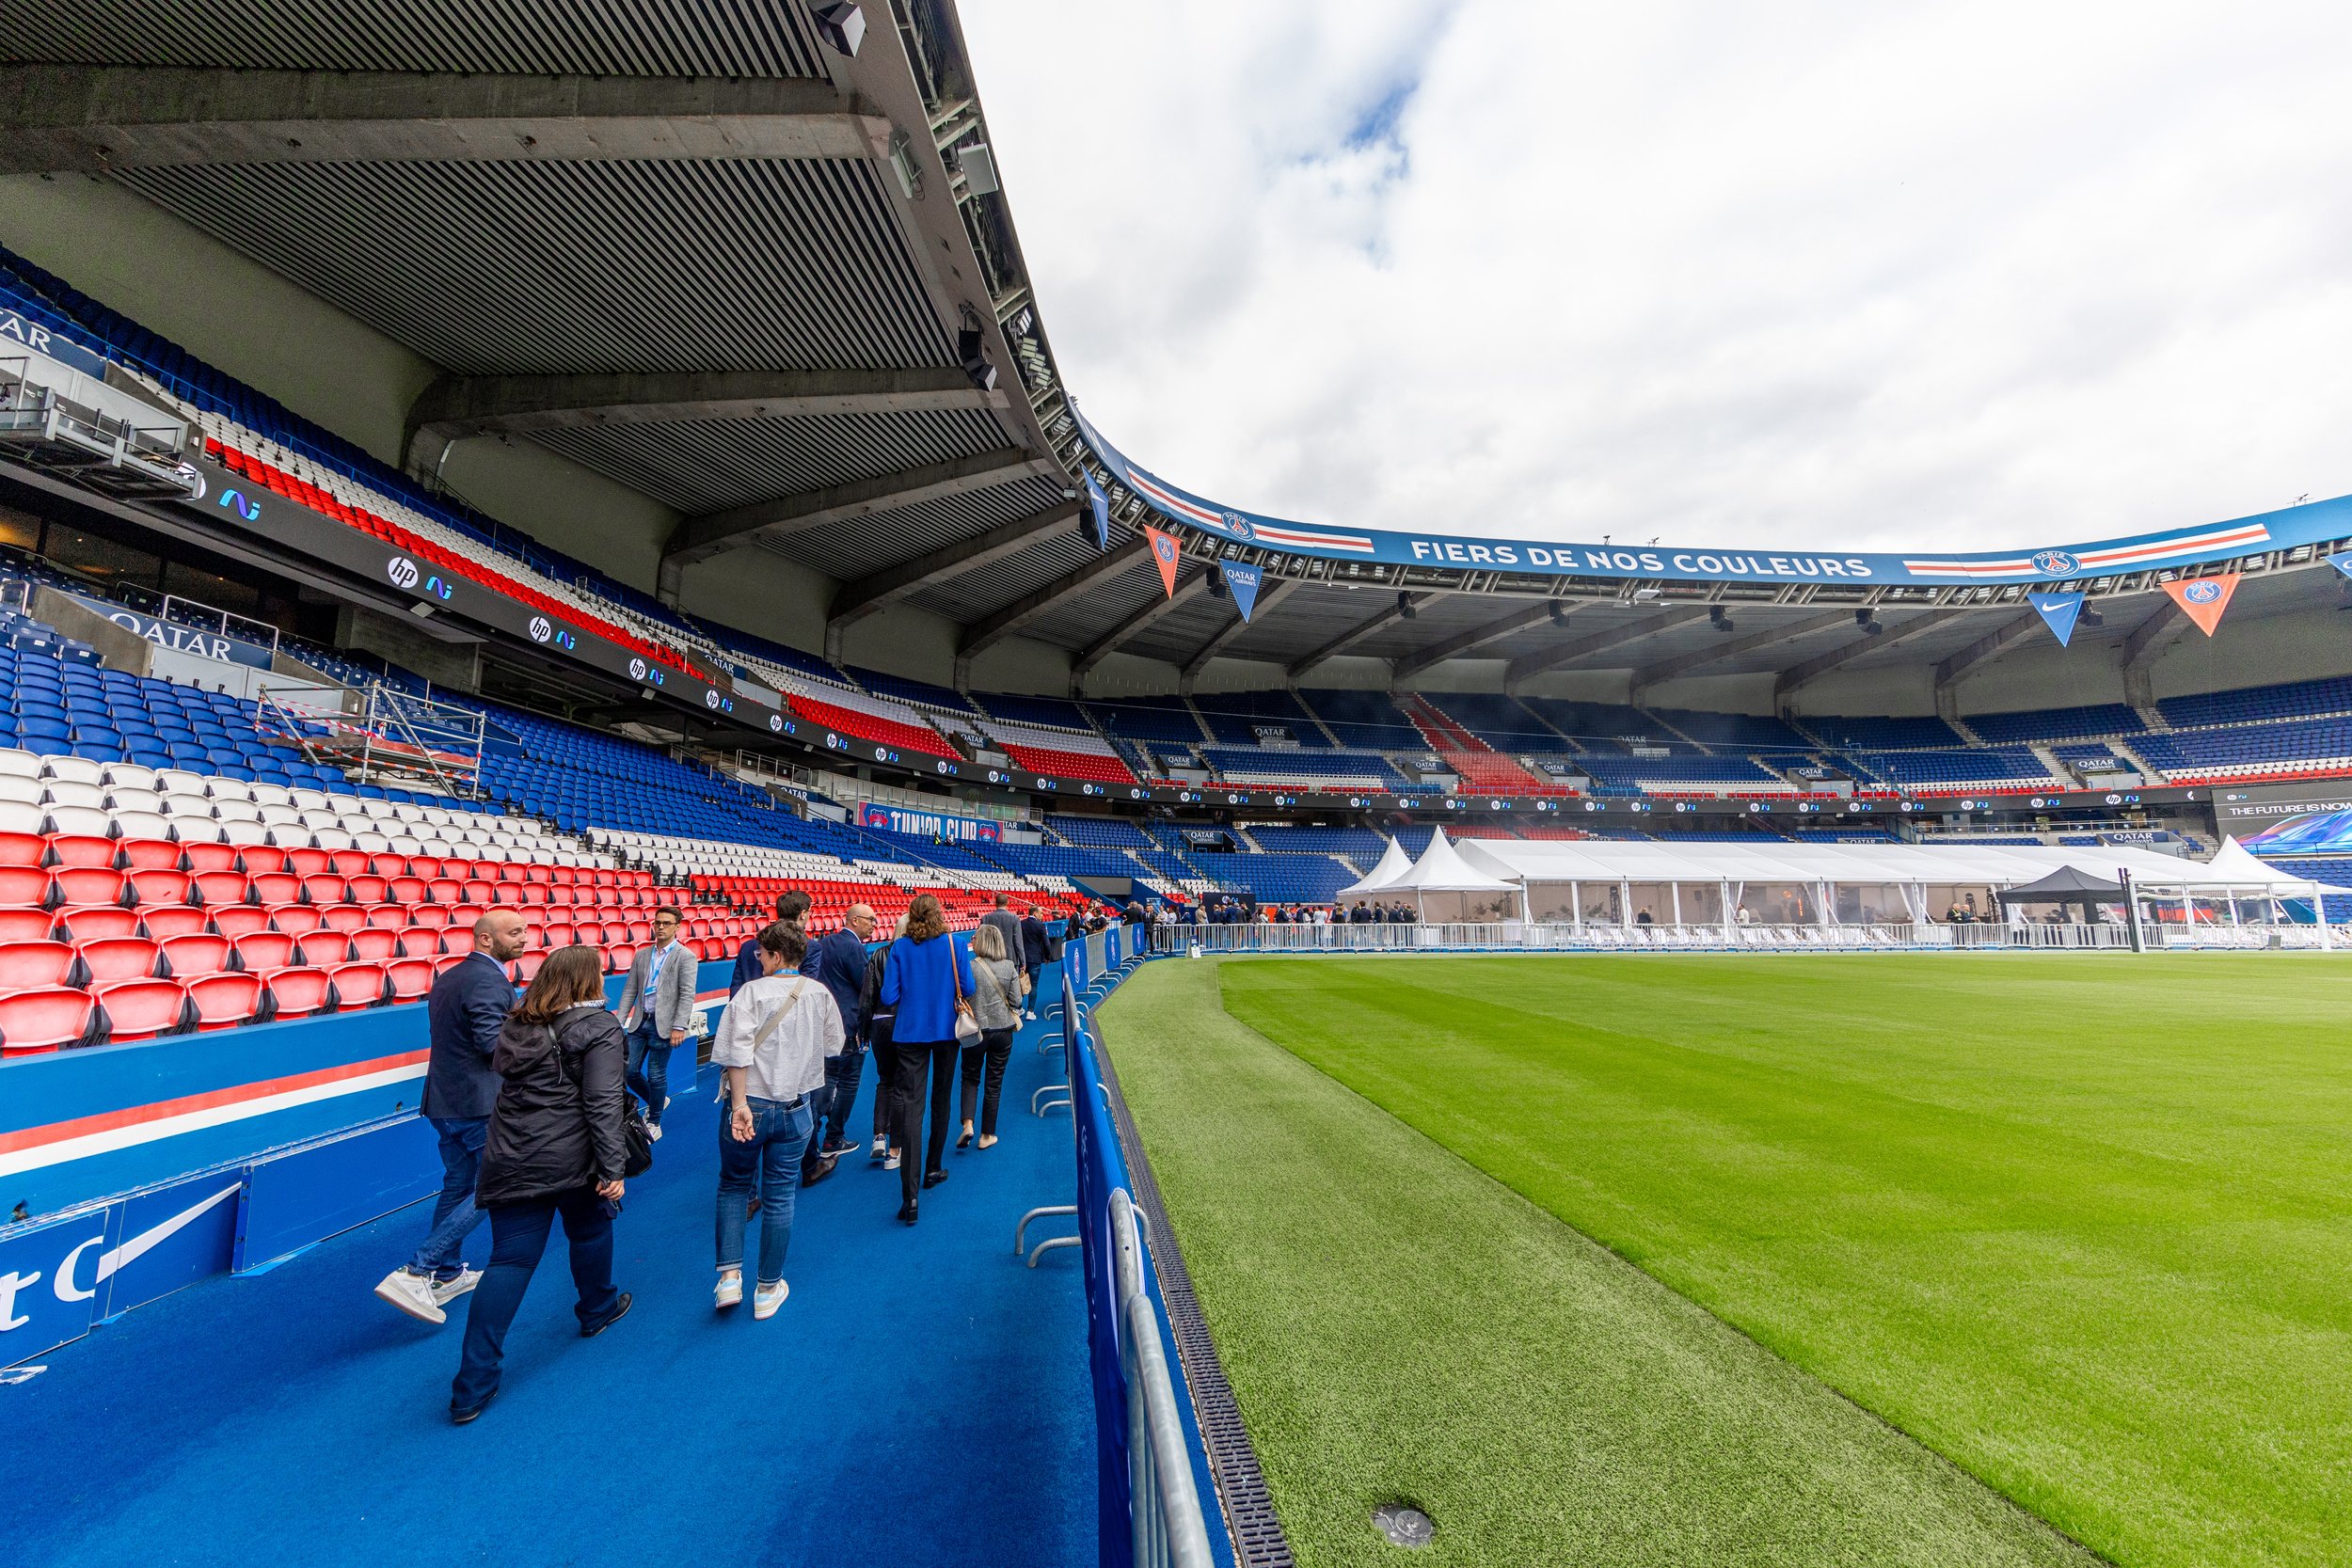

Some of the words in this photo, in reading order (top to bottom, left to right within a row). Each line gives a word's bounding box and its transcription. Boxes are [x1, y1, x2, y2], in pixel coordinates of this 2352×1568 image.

[0, 311, 51, 354] AR
[1410, 541, 1518, 564] FIERS
[1527, 547, 1580, 568] DE
[1584, 551, 1665, 572] NOS
[1673, 554, 1872, 577] COULEURS
[2035, 551, 2066, 560] PARIS
[390, 557, 416, 588] hp
[1227, 569, 1256, 581] QATAR
[2189, 581, 2214, 590] PARIS
[531, 617, 549, 641] hp
[630, 658, 644, 680] hp
[707, 690, 718, 708] hp
[771, 715, 782, 731] hp
[1254, 727, 1285, 736] QATAR
[827, 734, 836, 748] hp
[876, 748, 886, 761] hp
[938, 761, 946, 773] hp
[2078, 759, 2115, 768] QATAR
[989, 771, 998, 782] hp
[1962, 800, 1973, 810] hp
[2032, 799, 2043, 808] hp
[2106, 795, 2121, 804] hp
[2229, 807, 2255, 816] THE
[2255, 804, 2305, 815] FUTURE
[2306, 803, 2320, 812] IS
[2320, 801, 2352, 811] NOW
[1003, 821, 1017, 830] TAR
[1190, 832, 1214, 840] QATAR
[2113, 832, 2153, 841] QATAR
